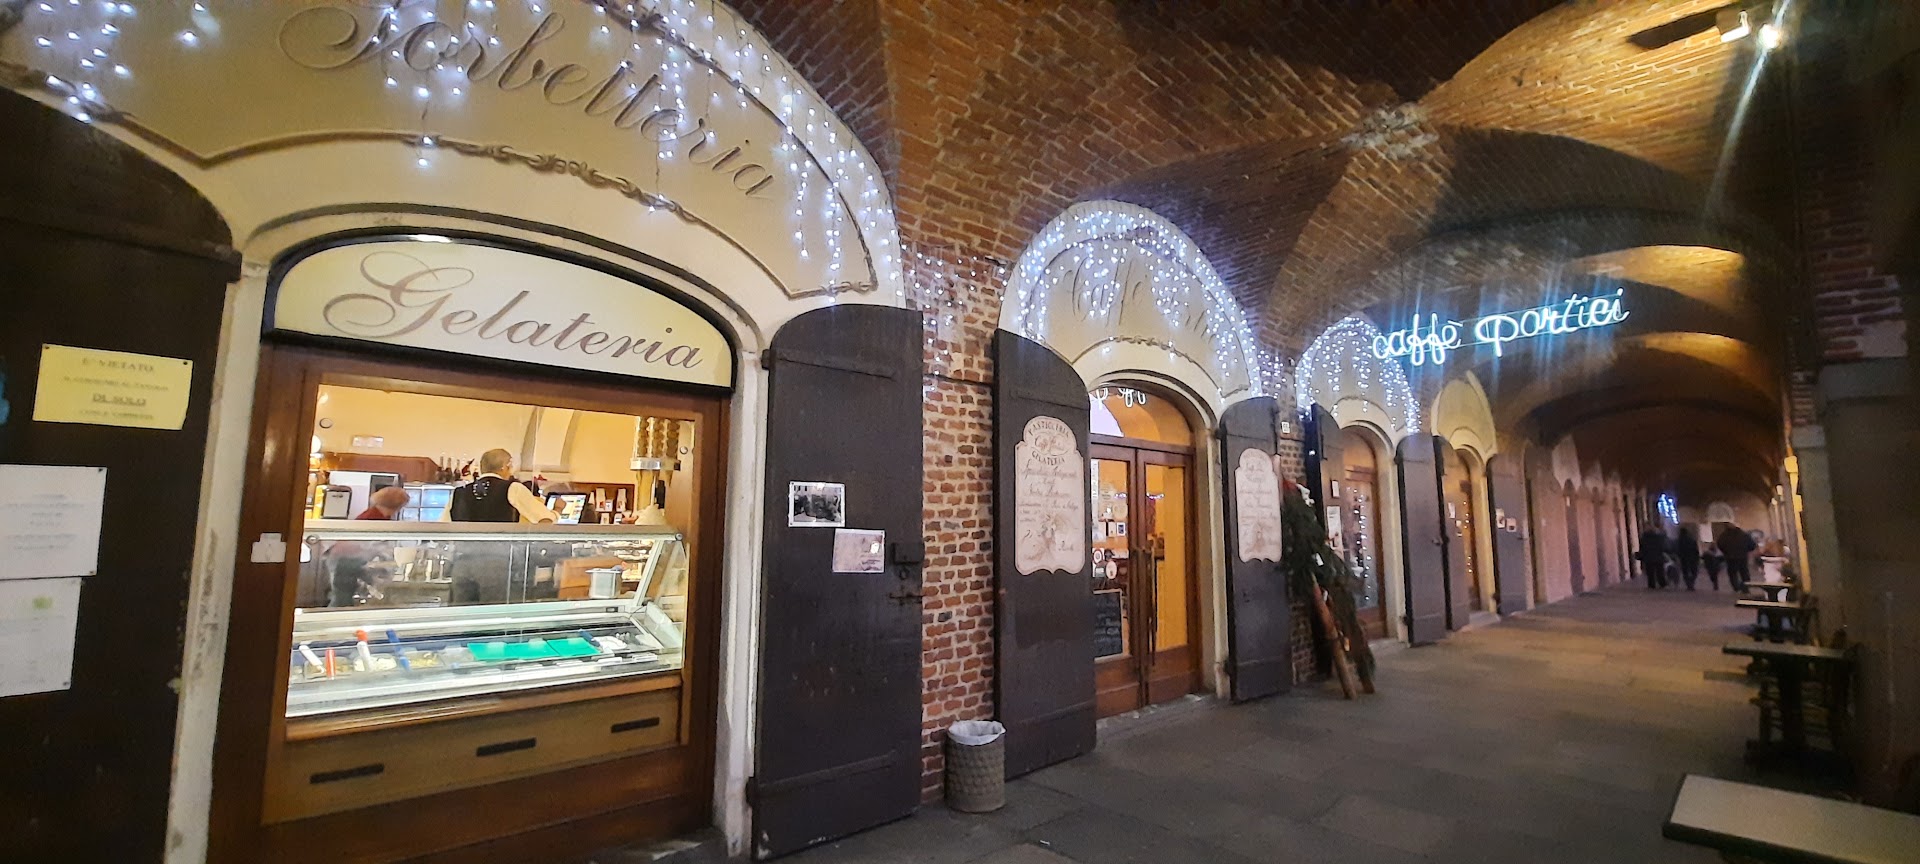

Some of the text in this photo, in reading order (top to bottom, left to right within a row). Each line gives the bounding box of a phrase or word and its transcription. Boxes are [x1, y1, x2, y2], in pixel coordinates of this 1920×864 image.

[323, 250, 703, 369] Gelateria
[99, 359, 155, 373] VIETATO
[1372, 312, 1463, 366] caffè
